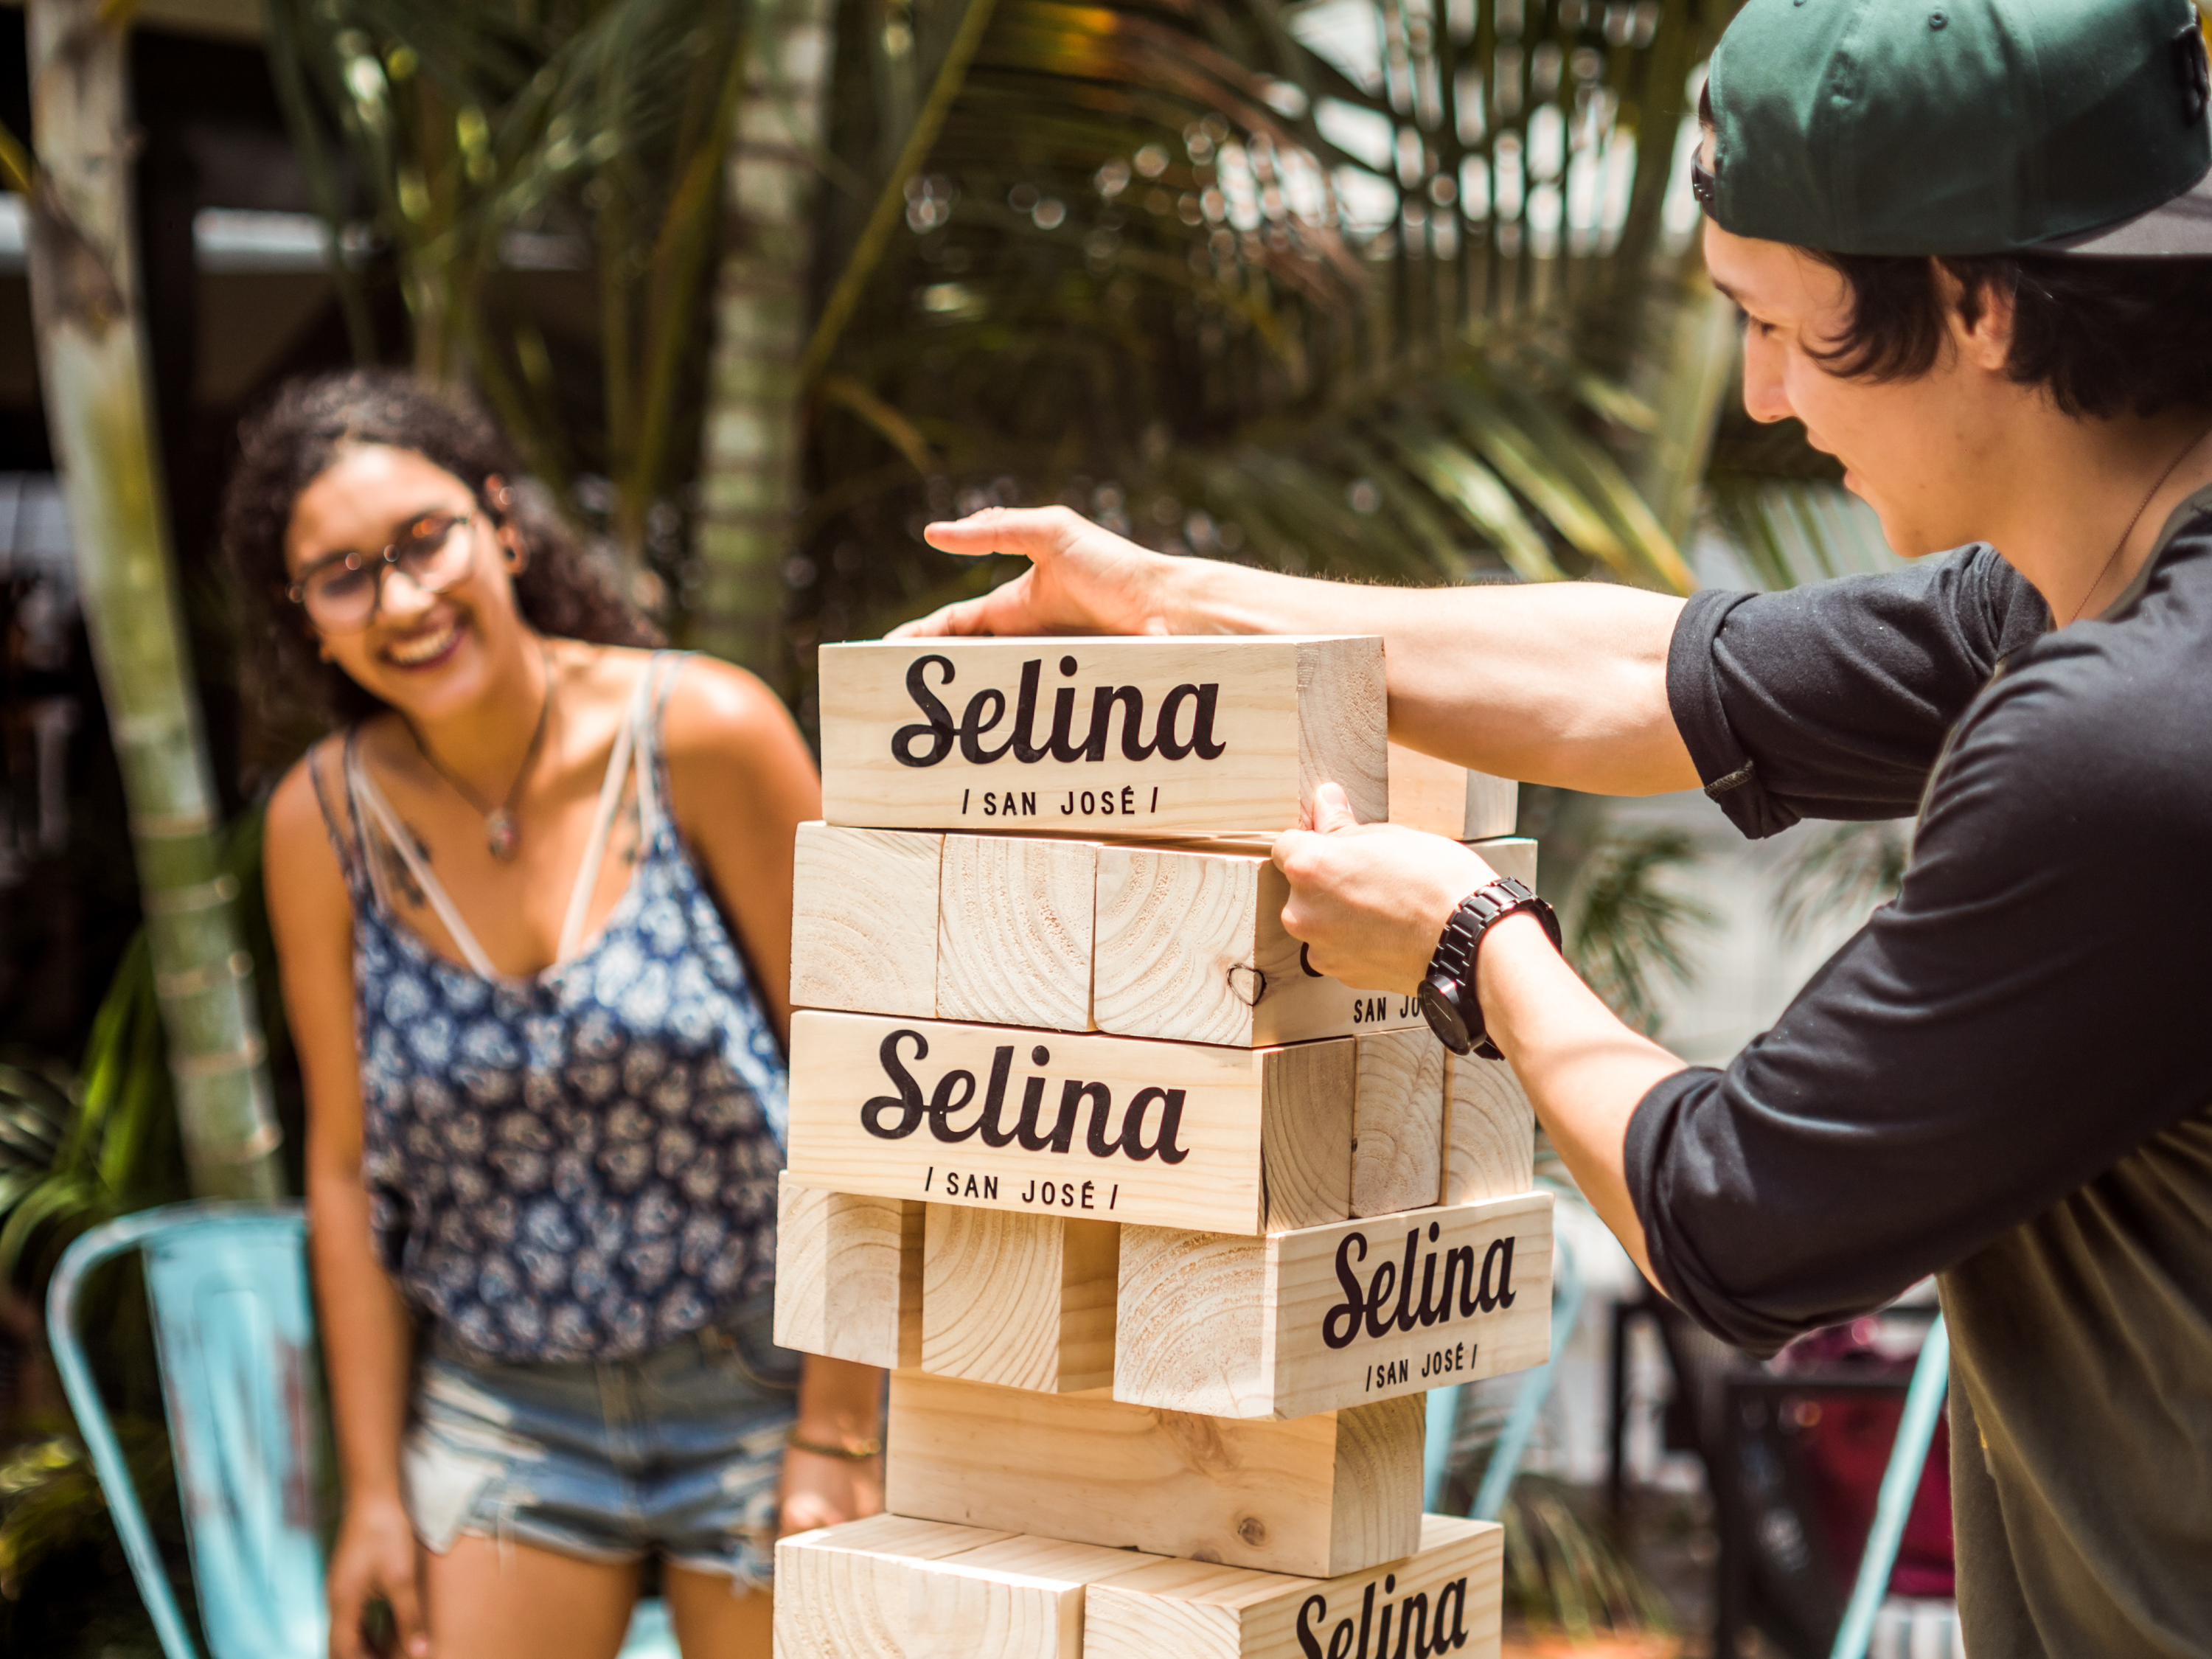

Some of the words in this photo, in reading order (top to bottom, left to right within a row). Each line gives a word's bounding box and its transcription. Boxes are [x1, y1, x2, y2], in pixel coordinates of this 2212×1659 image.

[891, 654, 1226, 768] Selina
[1353, 997, 1386, 1023] SAN
[1399, 995, 1419, 1018] JO
[860, 1029, 1189, 1164] Selina
[1322, 1221, 1517, 1349] Selina
